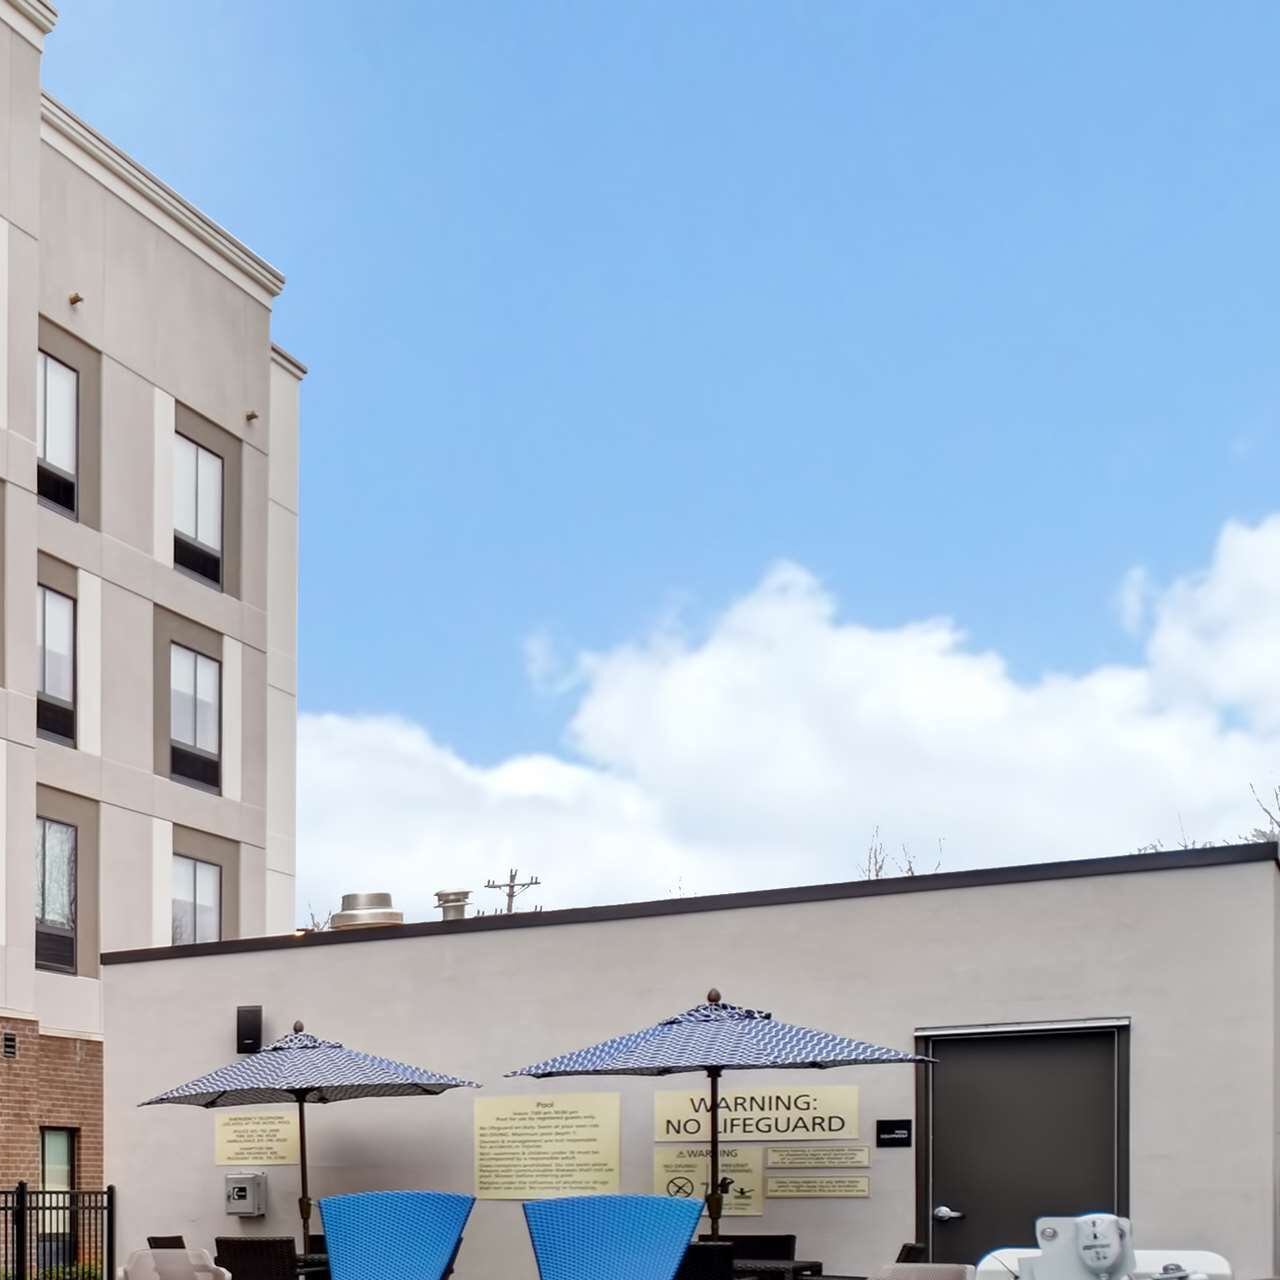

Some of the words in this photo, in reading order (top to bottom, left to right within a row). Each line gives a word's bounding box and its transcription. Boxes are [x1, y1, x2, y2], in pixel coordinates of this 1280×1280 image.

[690, 1094, 818, 1113] WARNING:
[666, 1119, 701, 1134] NO
[687, 1149, 738, 1158] WARING
